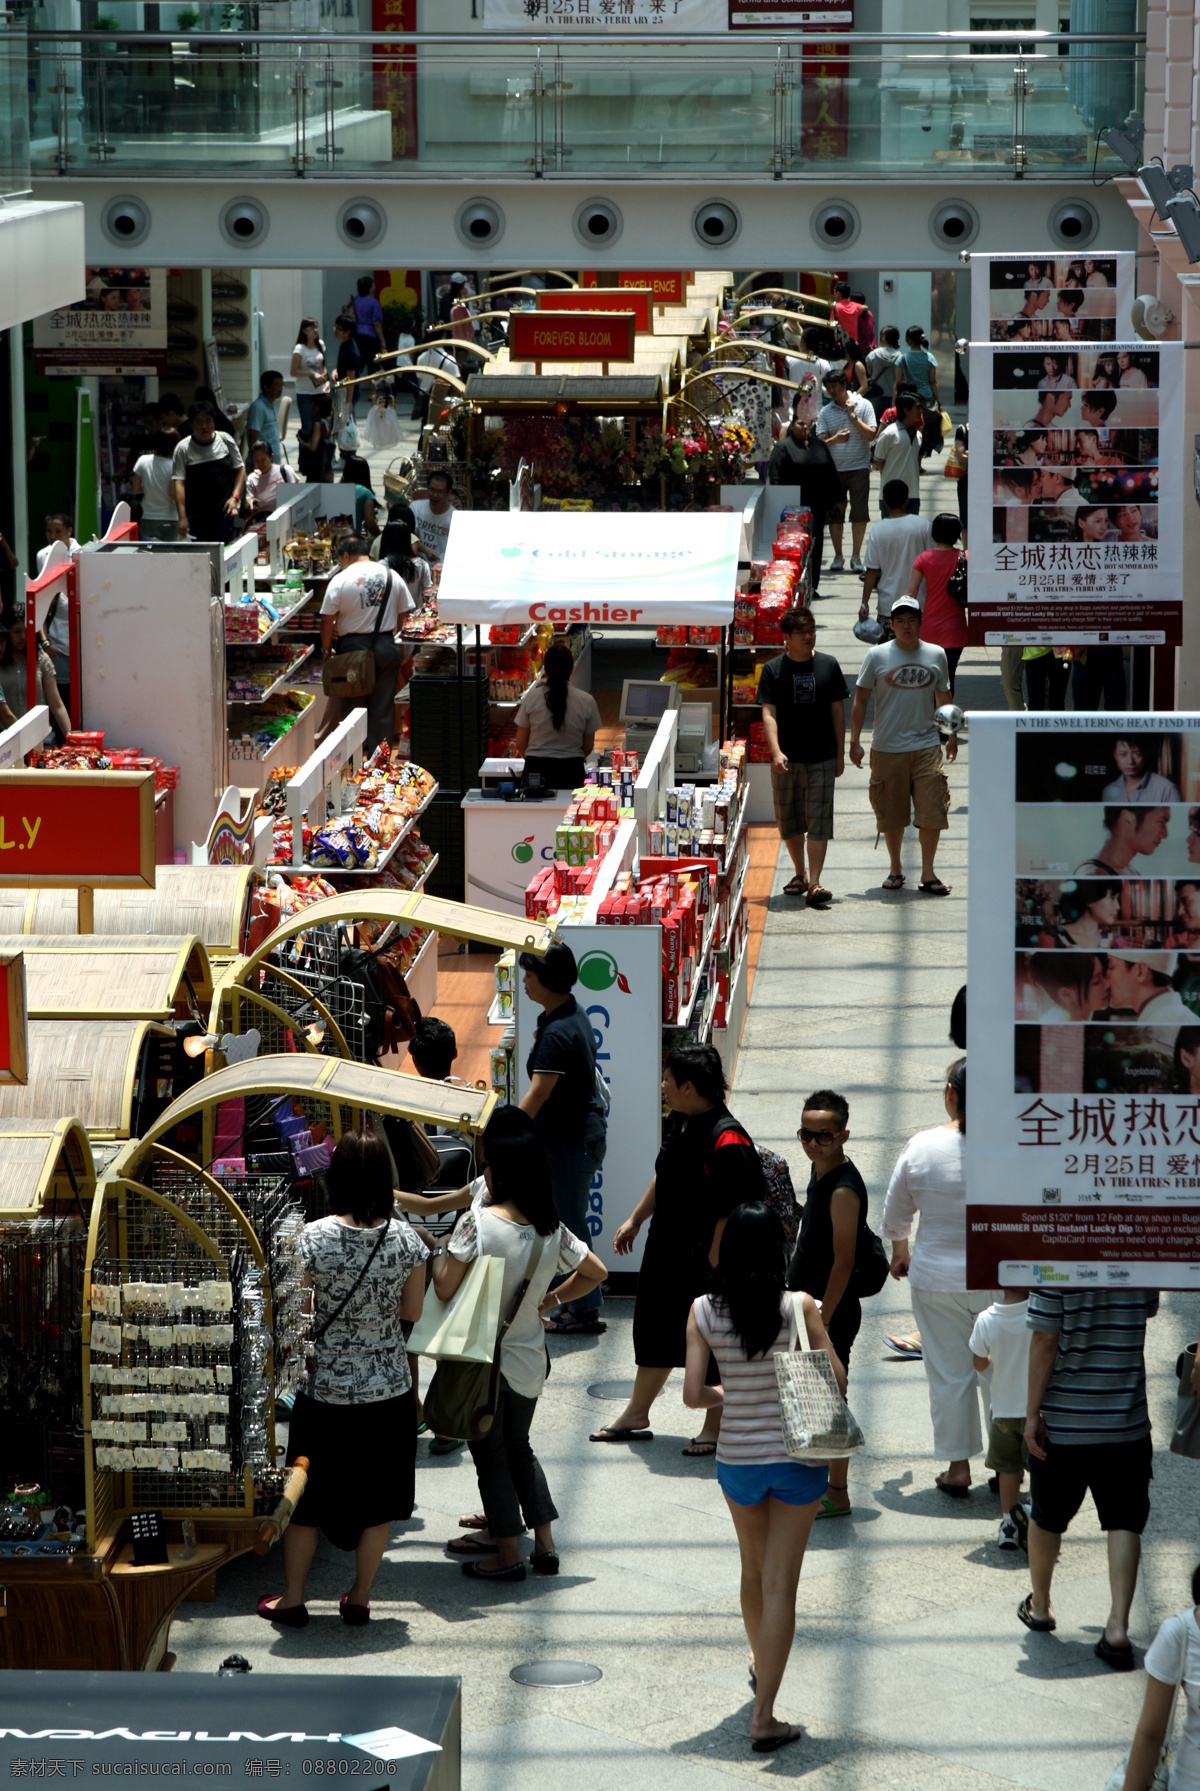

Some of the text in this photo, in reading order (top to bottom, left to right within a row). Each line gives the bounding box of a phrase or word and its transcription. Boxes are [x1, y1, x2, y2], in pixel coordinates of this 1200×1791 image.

[545, 16, 664, 24] IN THEATRES FEBRUARY 25
[50, 313, 117, 329] 全城热恋
[533, 331, 611, 346] FOREVER BLOOM
[423, 531, 435, 542] TO
[994, 544, 1158, 571] 全城热恋 热辣辣
[1018, 574, 1066, 586] 2月25日
[528, 602, 643, 622] Cashier
[1015, 718, 1200, 728] IN THE SWELTERING HEAT FIND TH
[1124, 1067, 1161, 1077] Angelababy
[1064, 1154, 1154, 1175] 2月25日
[1094, 1177, 1106, 1187] IN
[1110, 1177, 1170, 1188] THEATRES
[1021, 1213, 1047, 1223] Spend
[1075, 1213, 1094, 1223] from
[1096, 1213, 1106, 1223] 12
[1108, 1213, 1123, 1223] Feb
[1124, 1213, 1134, 1223] at
[1135, 1213, 1149, 1223] any
[1151, 1213, 1170, 1223] shop
[1172, 1213, 1180, 1223] in
[1182, 1213, 1200, 1223] Bugi
[971, 1223, 1200, 1233] HOT SUMMER DAYS Instant Lucky Dip to win an exclusi
[1042, 1234, 1085, 1244] CapitaCard
[1087, 1235, 1124, 1245] members
[1126, 1235, 1146, 1245] need
[1148, 1235, 1164, 1245] only
[1166, 1235, 1194, 1245] charge
[1032, 1264, 1054, 1276] Bugis
[1036, 1272, 1070, 1284] Junction
[0, 1727, 342, 1742] HANDYCA
